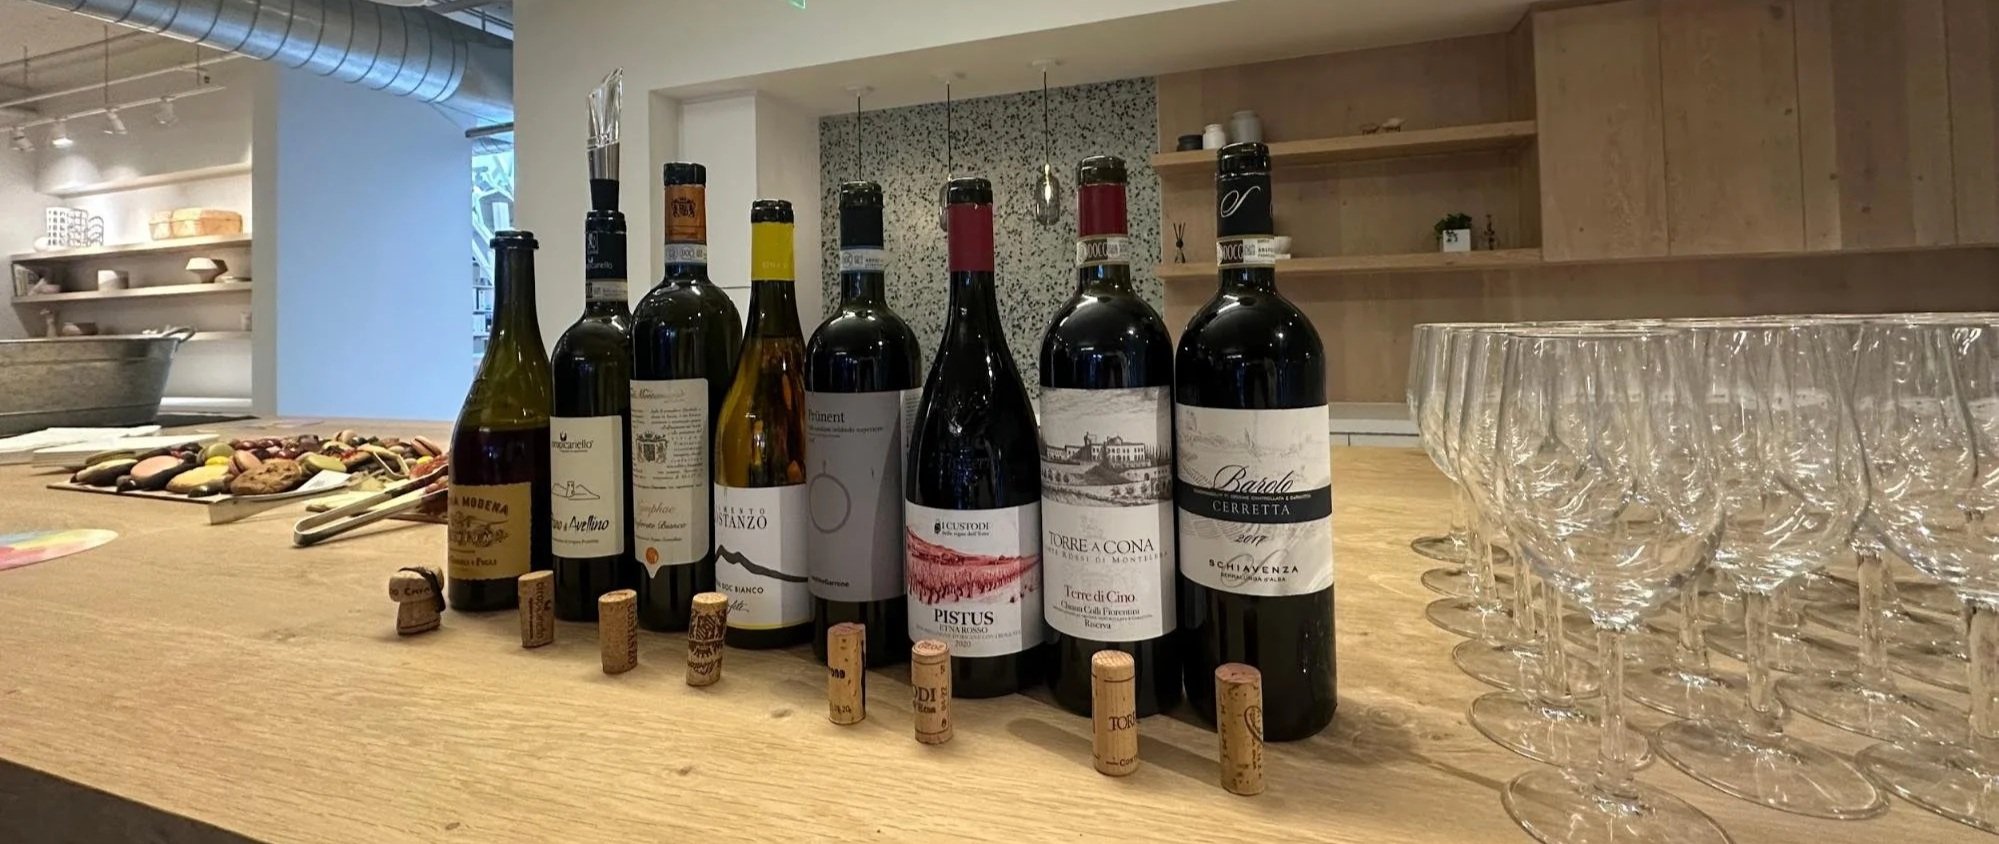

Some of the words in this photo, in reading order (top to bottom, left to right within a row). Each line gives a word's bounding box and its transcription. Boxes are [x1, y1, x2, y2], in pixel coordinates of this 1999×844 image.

[1213, 464, 1295, 495] Barolo
[462, 495, 509, 517] MODENA
[1212, 499, 1290, 516] CERRETTA
[569, 516, 609, 532] Avellino
[947, 521, 990, 531] CUSTODI
[1048, 530, 1088, 553] TORRE
[1091, 541, 1100, 552] A
[1103, 538, 1154, 555] CONA
[1235, 533, 1268, 547] 2017
[1208, 558, 1300, 574] SCHIAVENZA
[734, 586, 764, 595] BIANCO
[1064, 584, 1092, 601] Terre
[1093, 589, 1105, 603] di
[1106, 590, 1136, 603] Cino
[934, 608, 994, 626] PISTUS
[1084, 619, 1112, 630] Riserva
[961, 626, 989, 634] ROSSO
